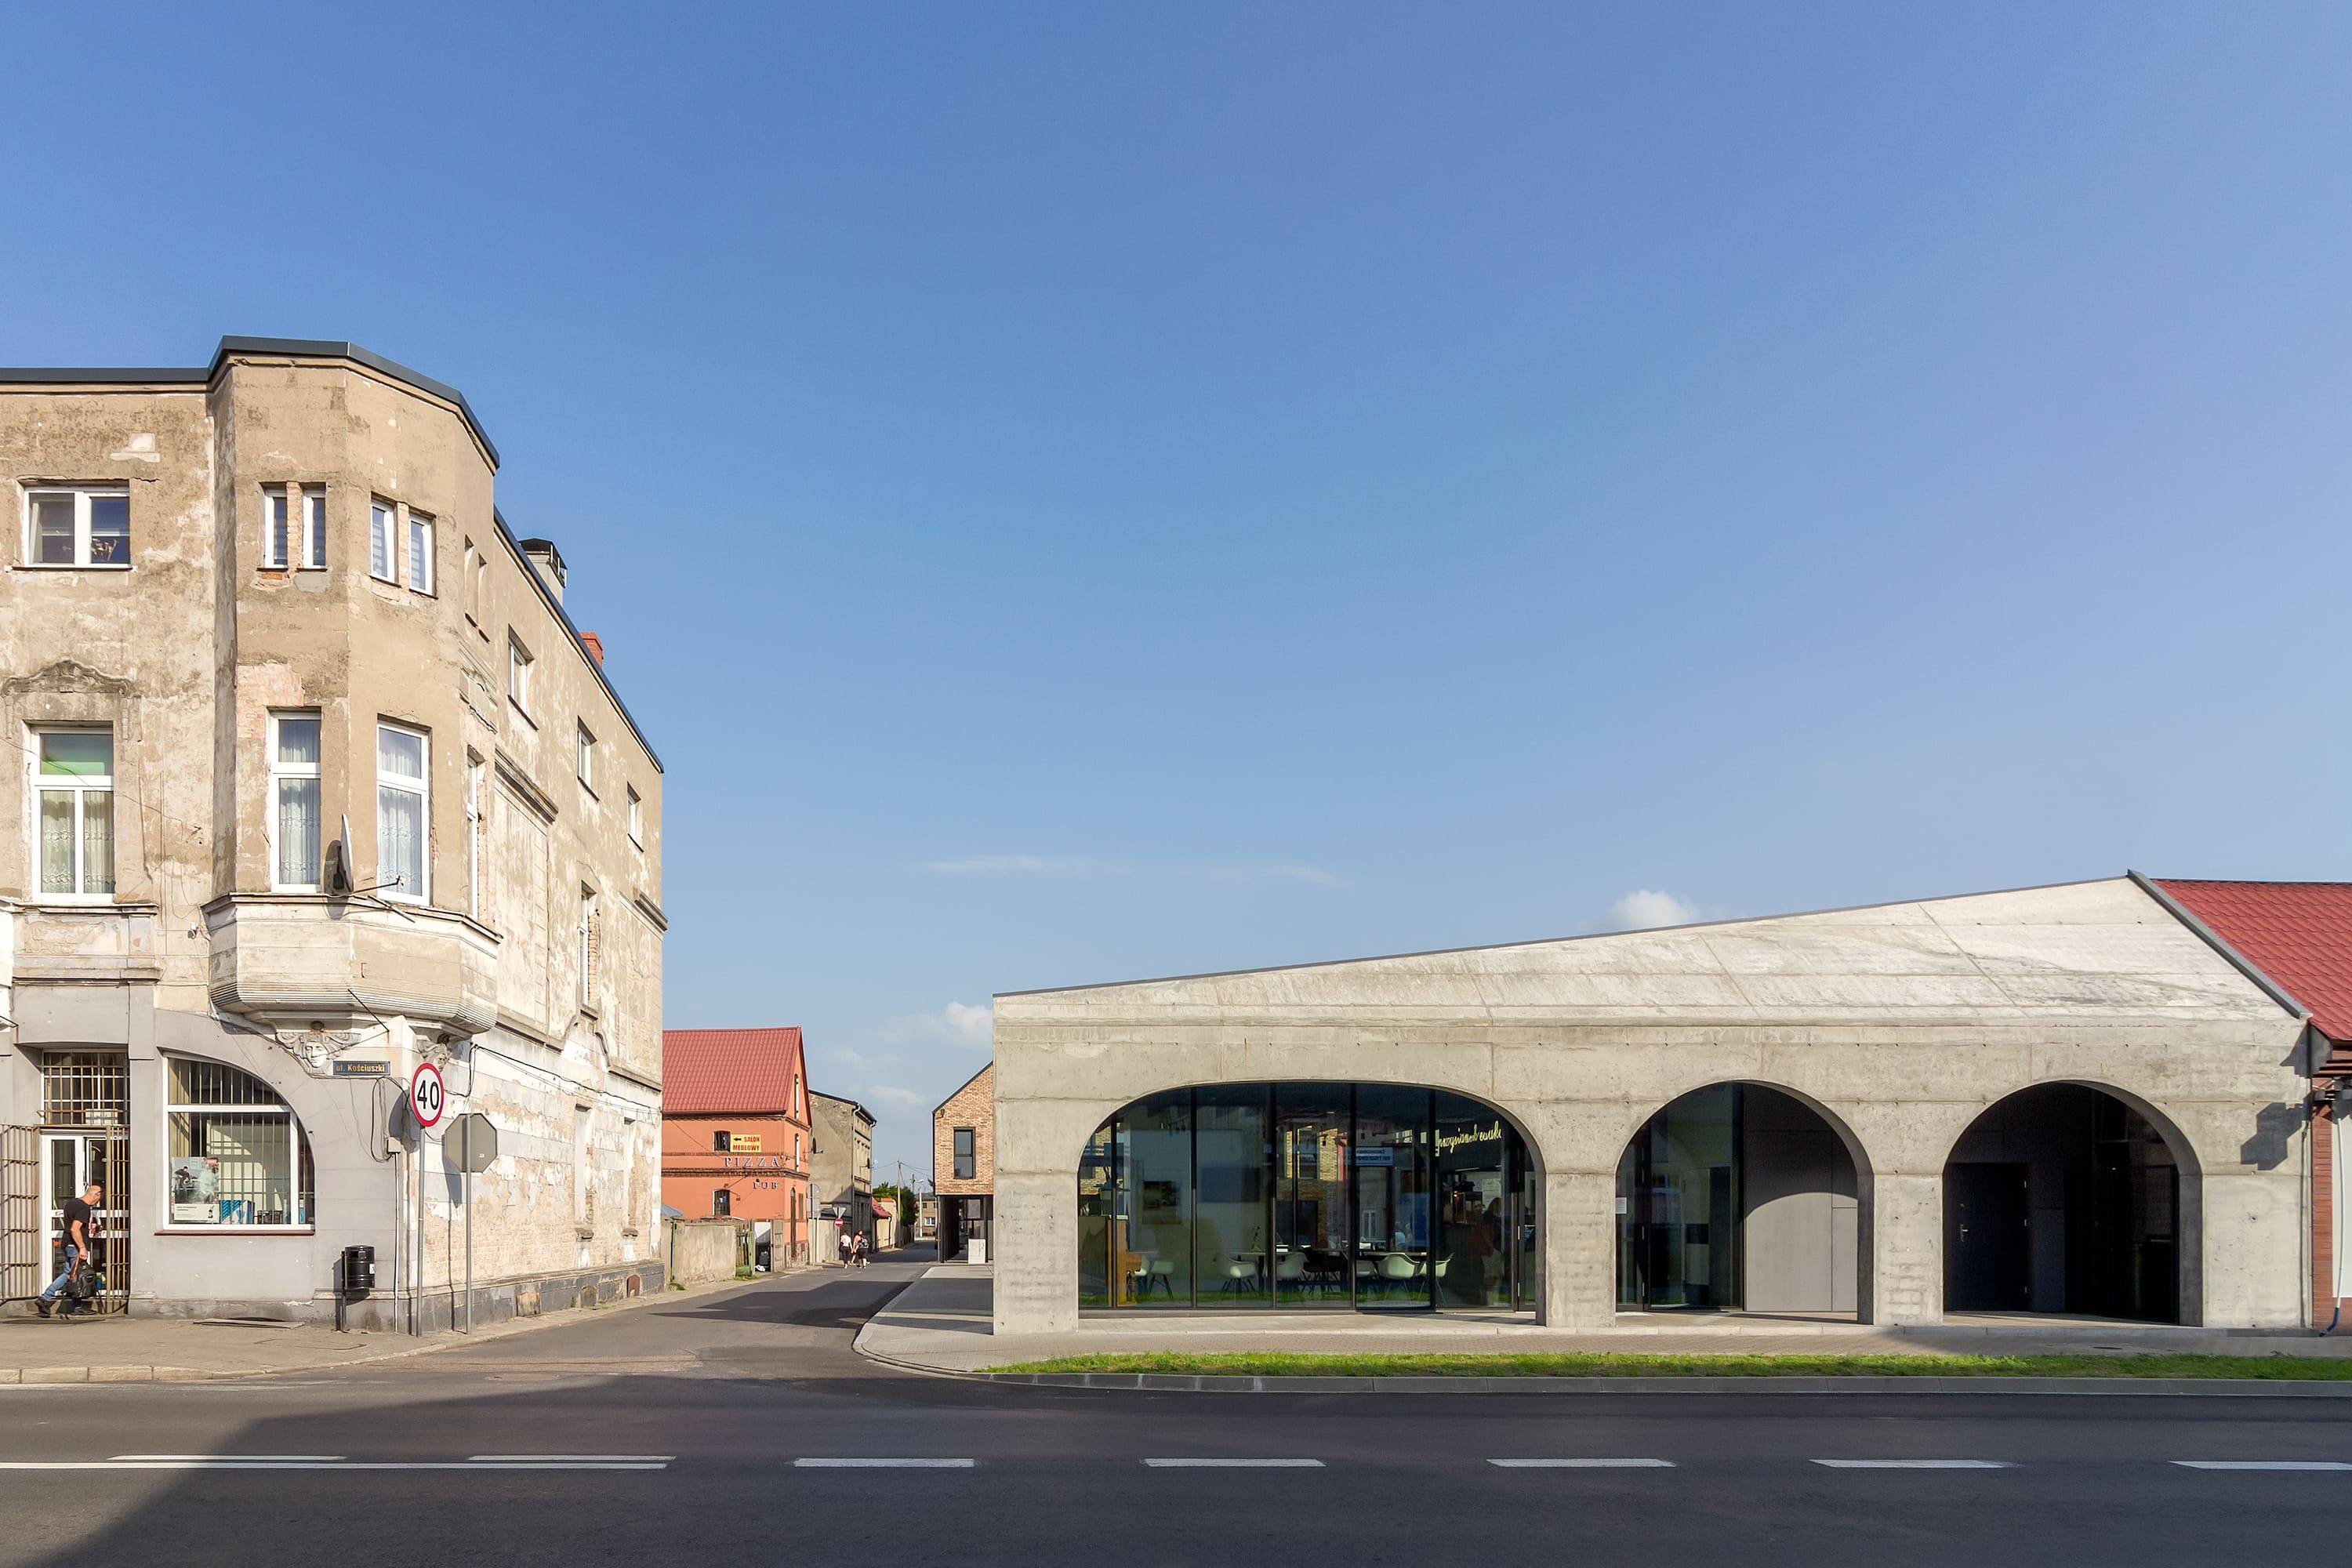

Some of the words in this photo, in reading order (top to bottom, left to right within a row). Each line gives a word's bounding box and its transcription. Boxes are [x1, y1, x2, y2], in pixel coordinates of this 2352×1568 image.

[347, 1063, 385, 1073] Kościuszki
[417, 1080, 440, 1110] 40
[724, 1156, 780, 1167] PIZZA
[753, 1181, 778, 1190] PUB
